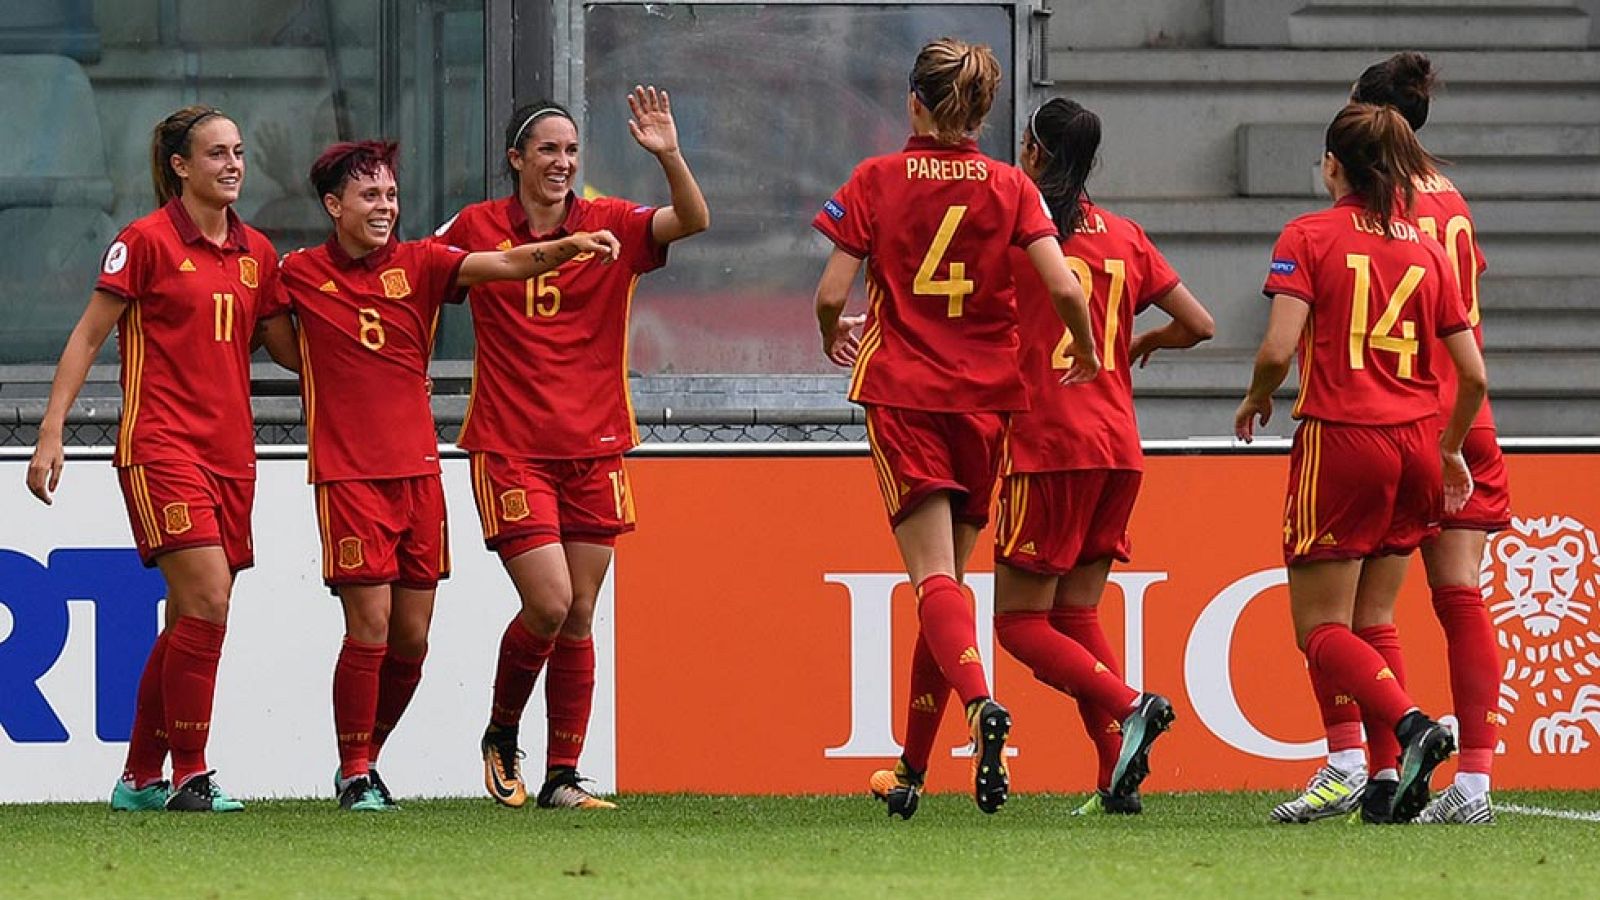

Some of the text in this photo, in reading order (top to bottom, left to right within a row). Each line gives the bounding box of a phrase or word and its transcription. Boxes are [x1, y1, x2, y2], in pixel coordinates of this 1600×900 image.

[906, 156, 989, 182] PAREDES
[525, 270, 562, 319] 15
[912, 205, 975, 318] 4
[1417, 214, 1480, 328] 0
[213, 293, 234, 342] 11
[358, 308, 386, 351] 8
[1051, 255, 1126, 371] 21
[1346, 253, 1426, 379] 14
